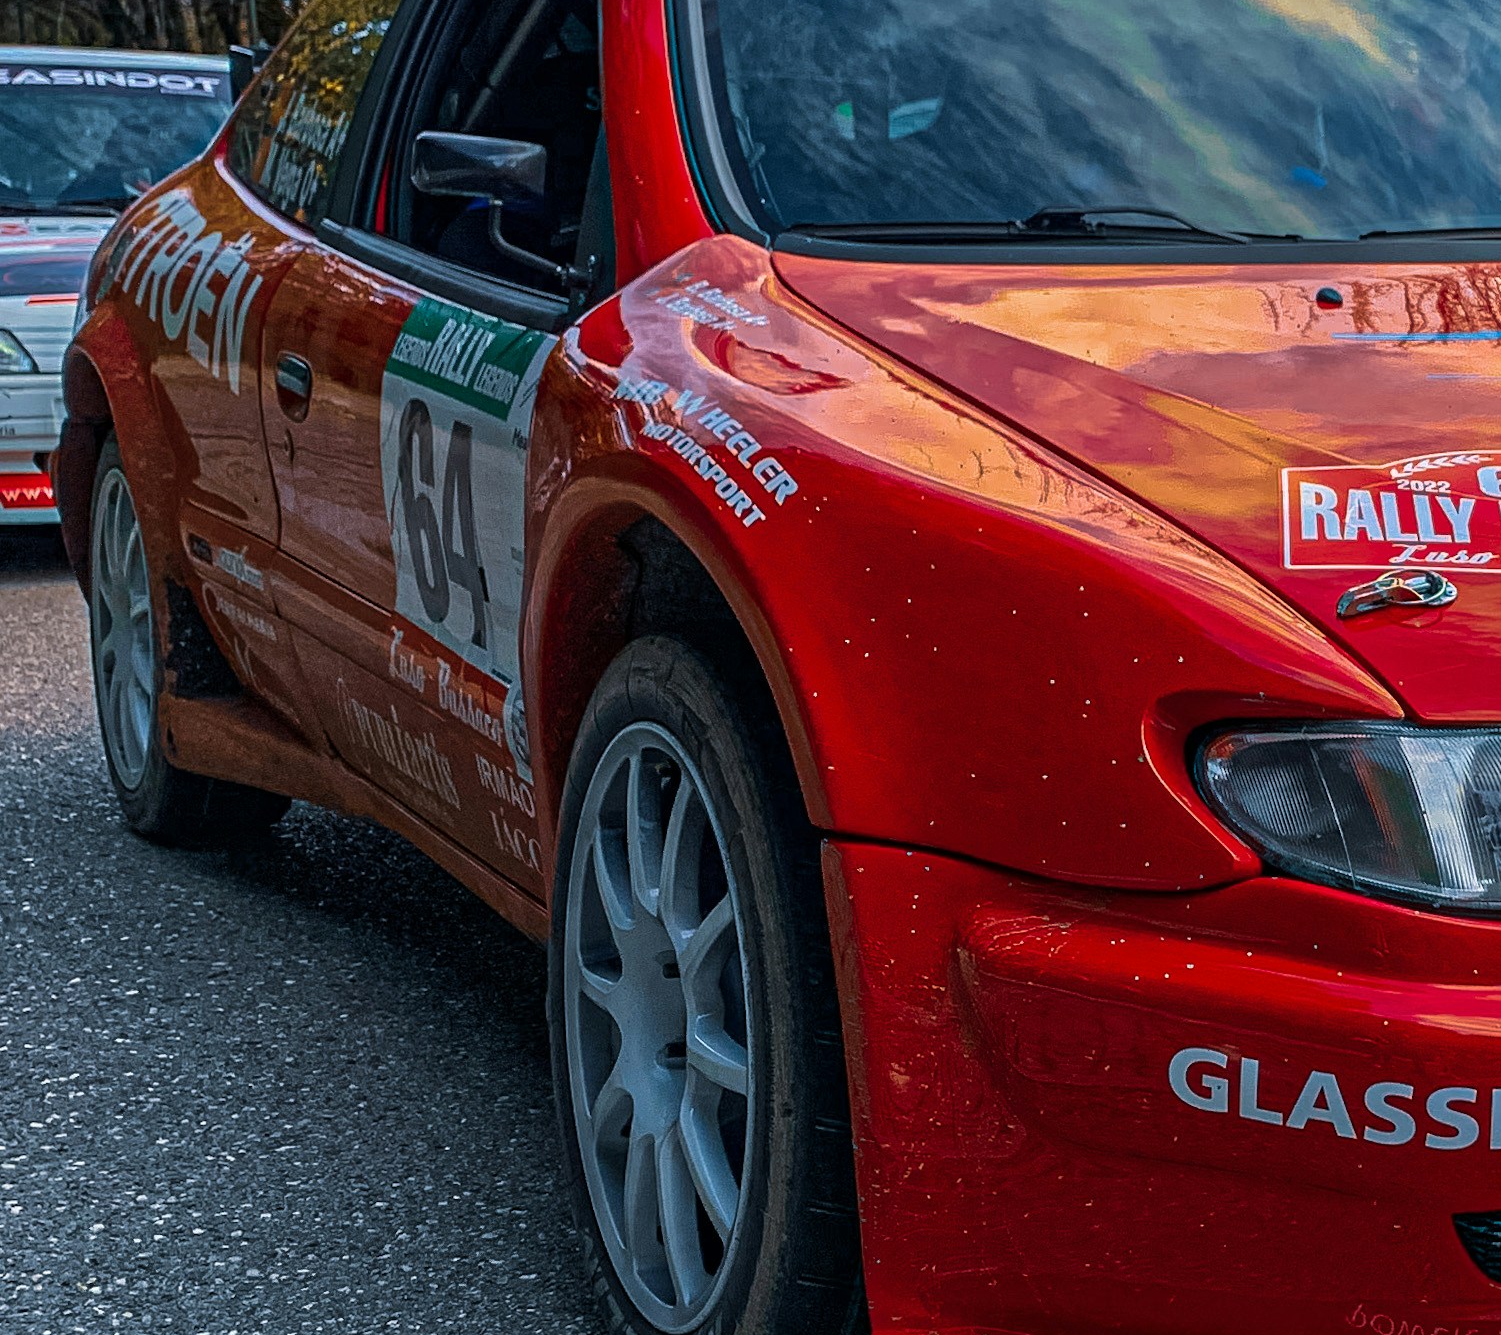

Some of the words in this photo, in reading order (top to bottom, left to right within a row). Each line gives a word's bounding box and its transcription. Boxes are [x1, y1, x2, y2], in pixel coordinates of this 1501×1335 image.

[423, 318, 497, 388] RALLY
[640, 419, 767, 528] MOTORSPORT
[672, 388, 799, 506] WHEELER
[1299, 481, 1477, 544] RALLY
[1396, 479, 1451, 494] 2022
[398, 398, 488, 651] 64
[1388, 542, 1500, 566] Luso
